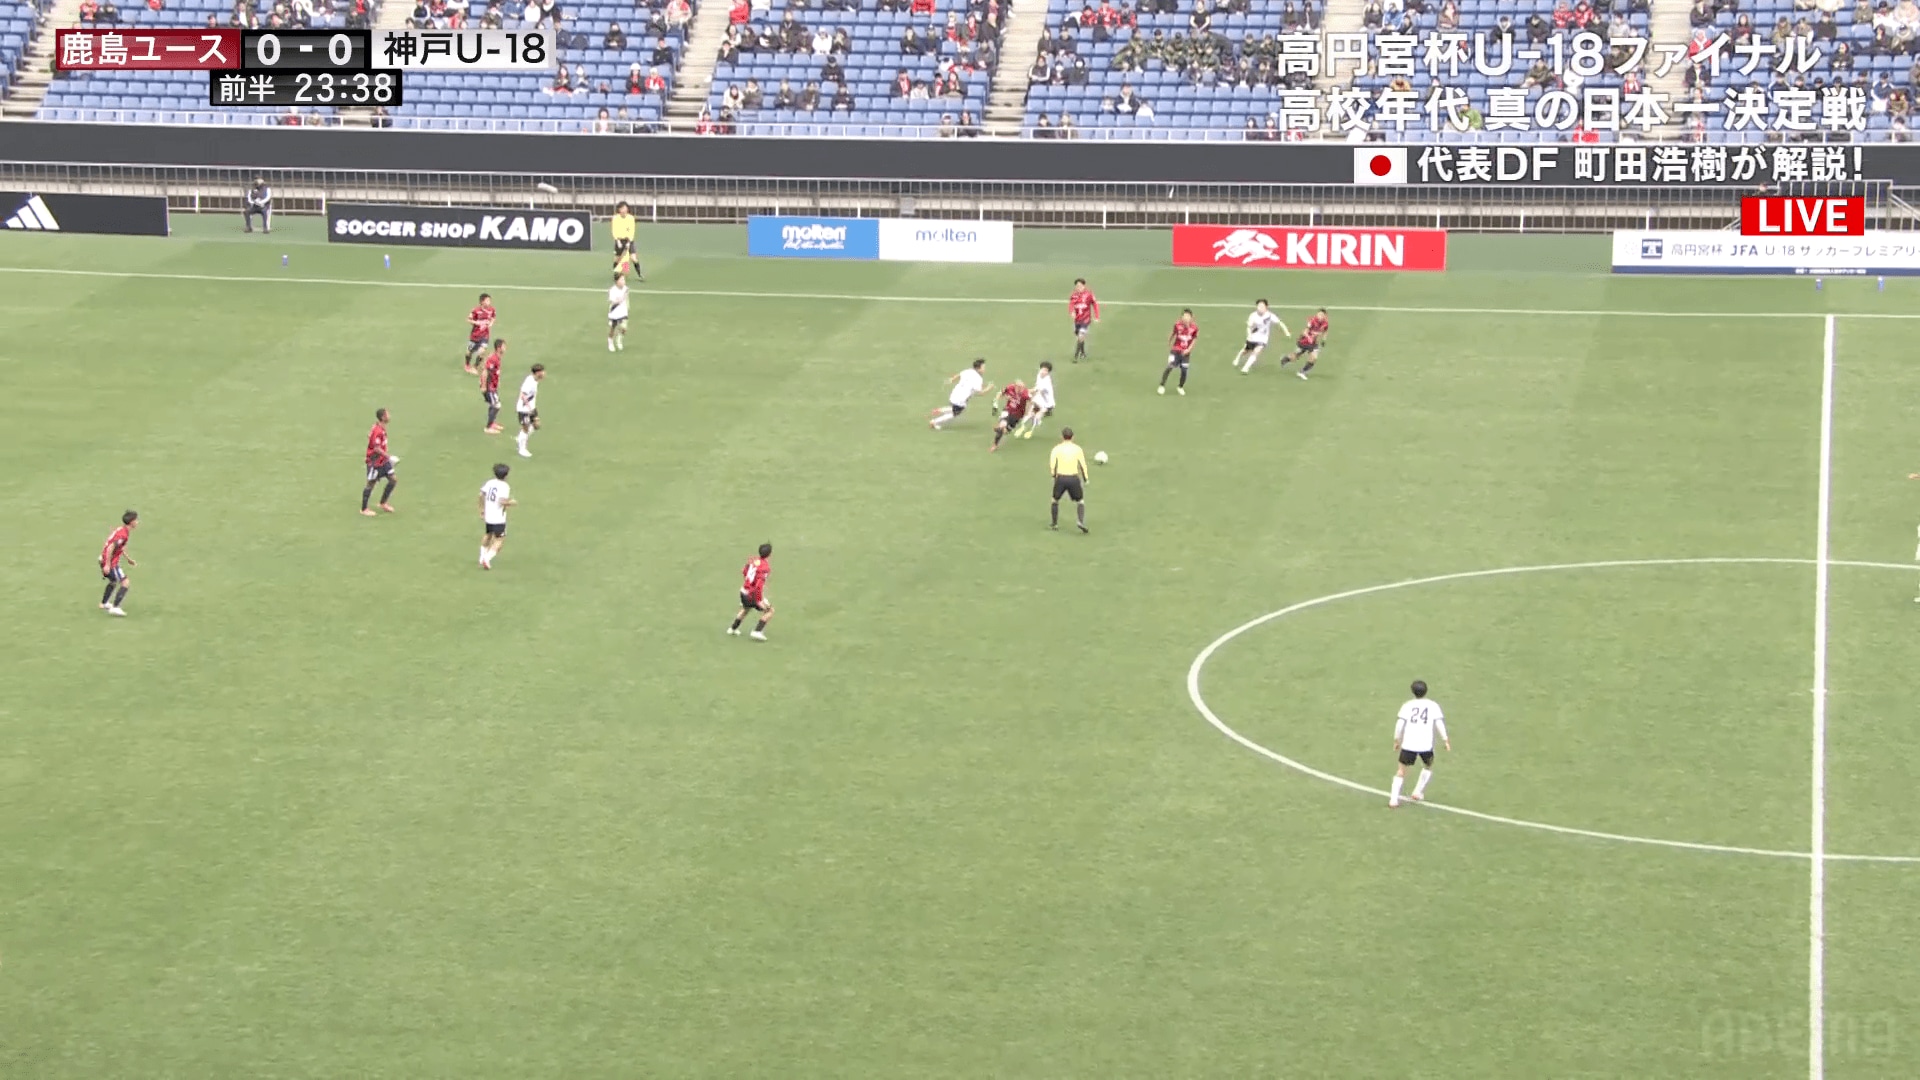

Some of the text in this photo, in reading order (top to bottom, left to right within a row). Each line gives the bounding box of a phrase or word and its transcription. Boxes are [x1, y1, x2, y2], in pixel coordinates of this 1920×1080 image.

[335, 216, 585, 244] SOCCER SHOP KAMO
[782, 224, 847, 241] molten
[915, 228, 978, 243] molten
[1286, 233, 1404, 267] KIRIN
[1730, 244, 1759, 257] JFA
[1410, 707, 1428, 724] 24
